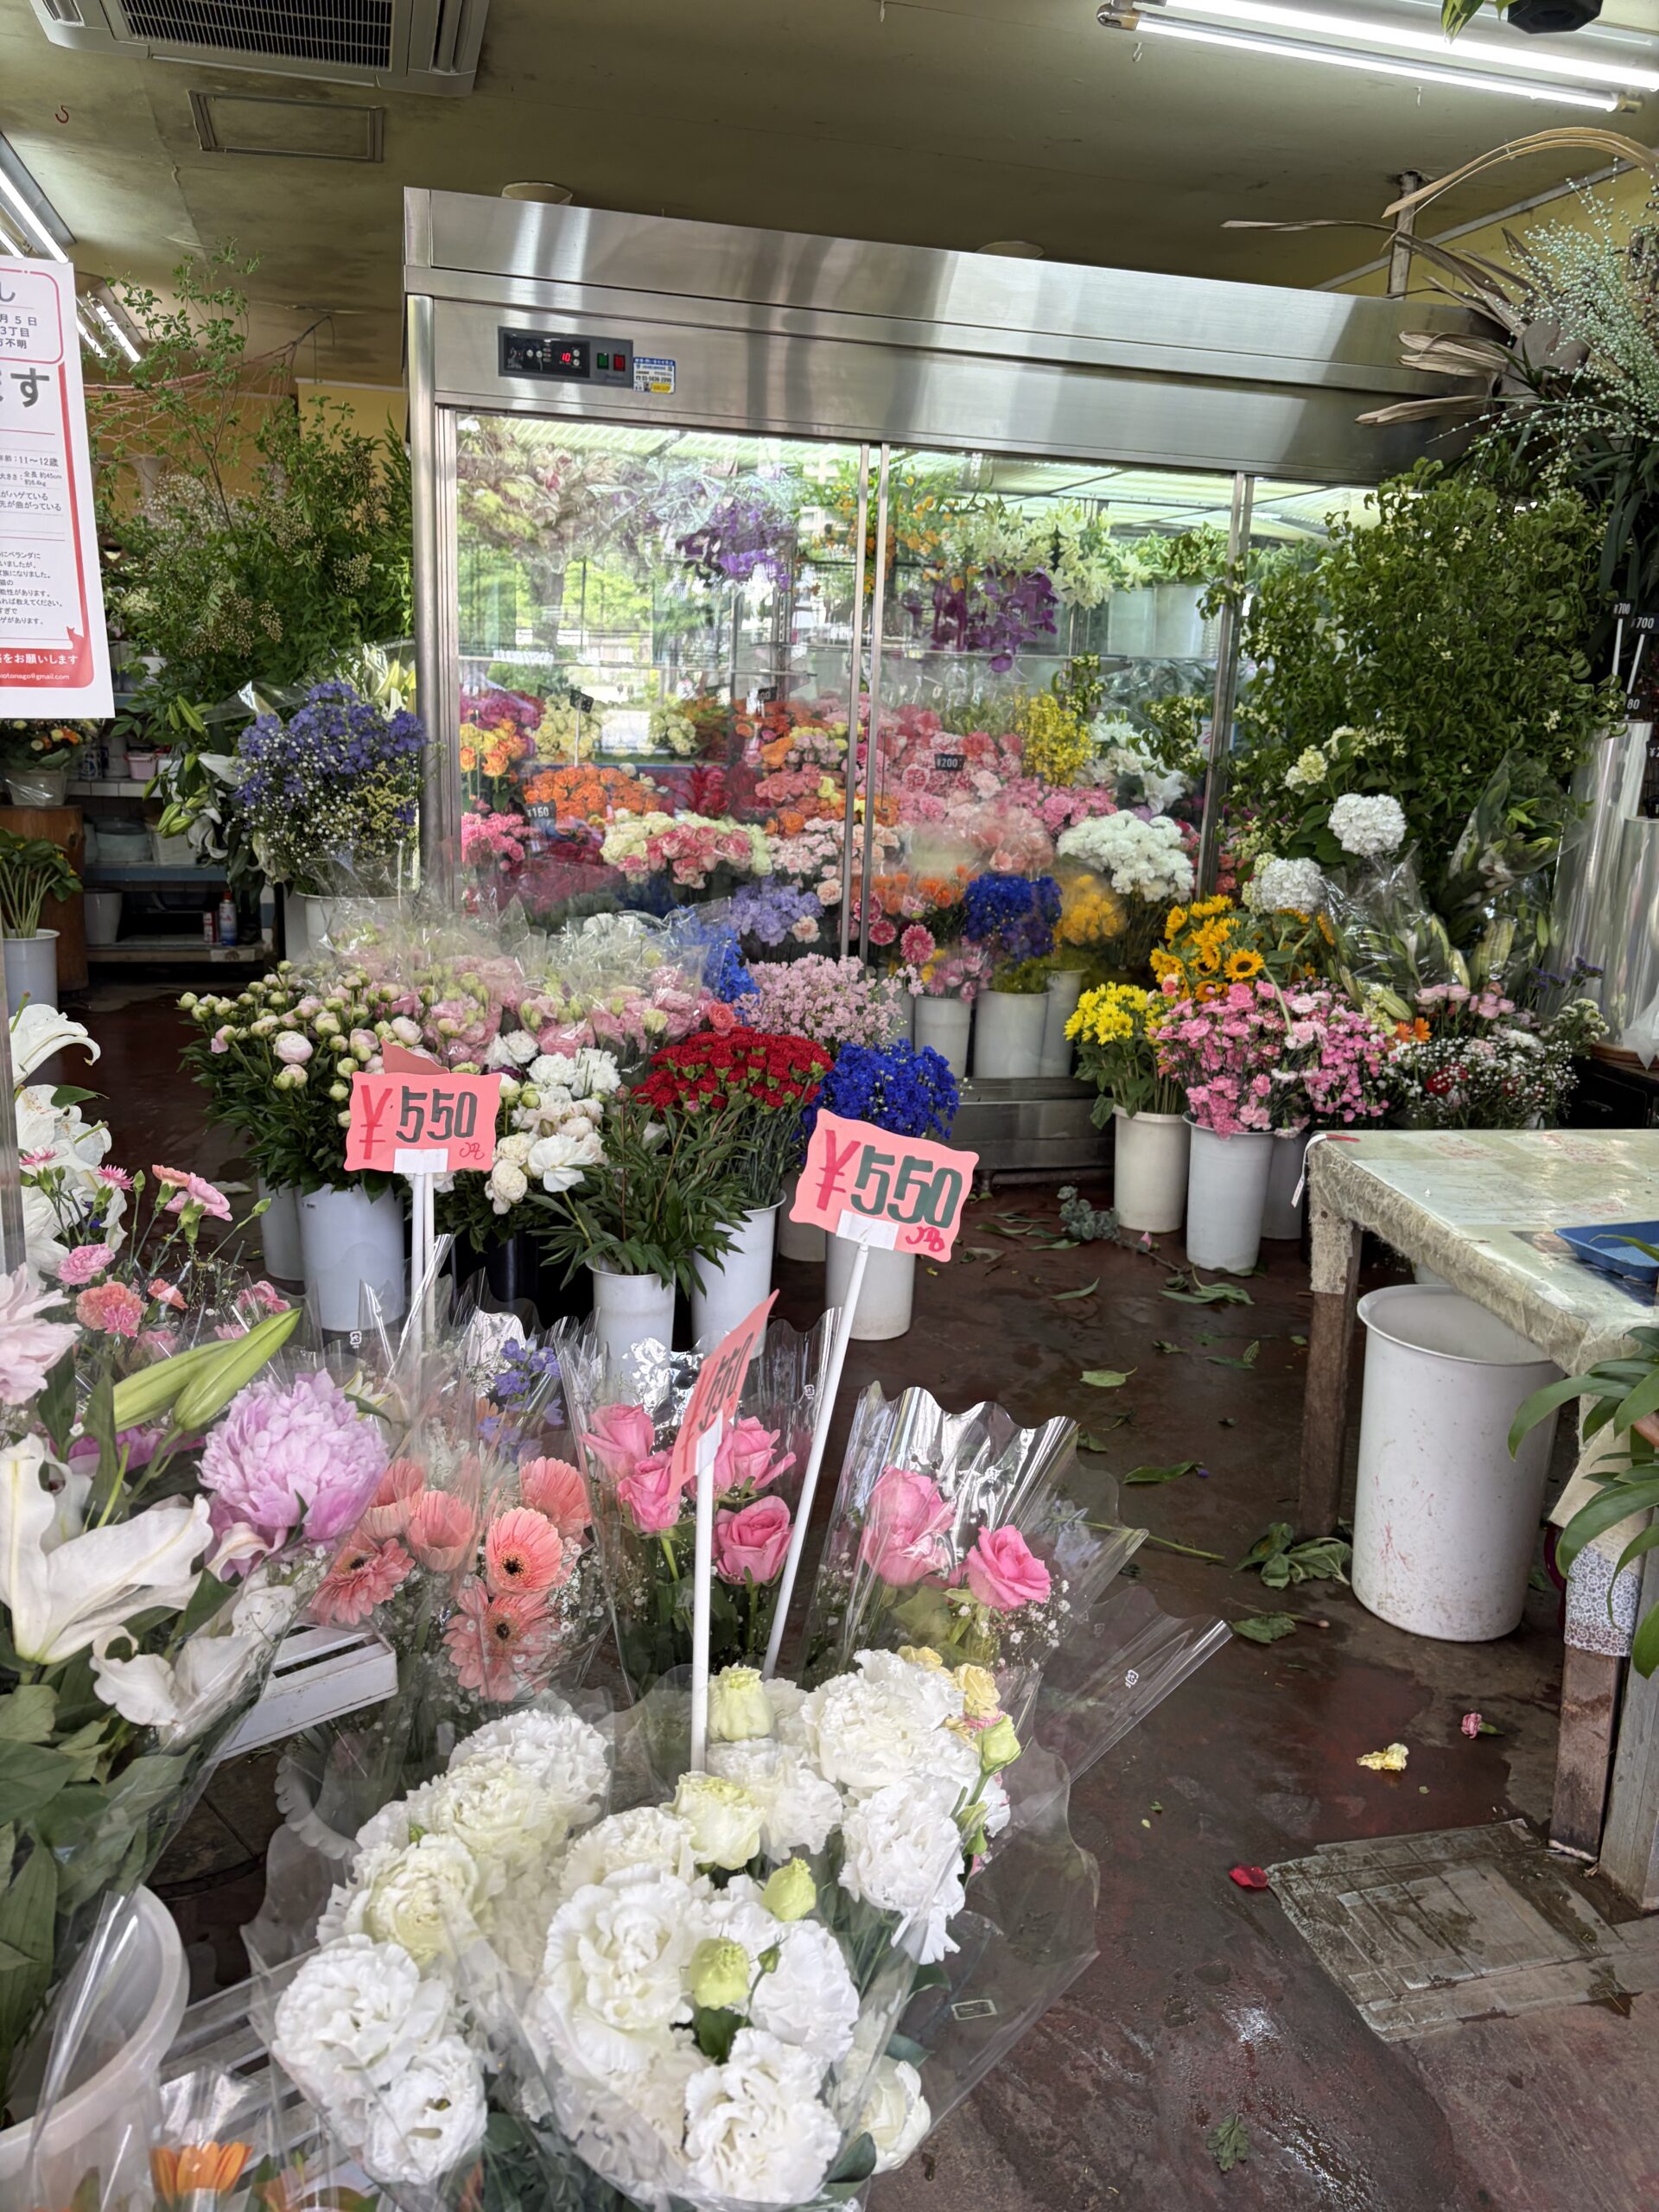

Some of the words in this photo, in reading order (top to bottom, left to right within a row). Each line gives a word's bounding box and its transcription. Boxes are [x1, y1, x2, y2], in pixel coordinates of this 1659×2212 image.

[0, 367, 50, 409] す
[0, 550, 41, 560] にベランダに
[0, 598, 62, 607] れば教えてください。
[0, 653, 79, 664] をお願いします
